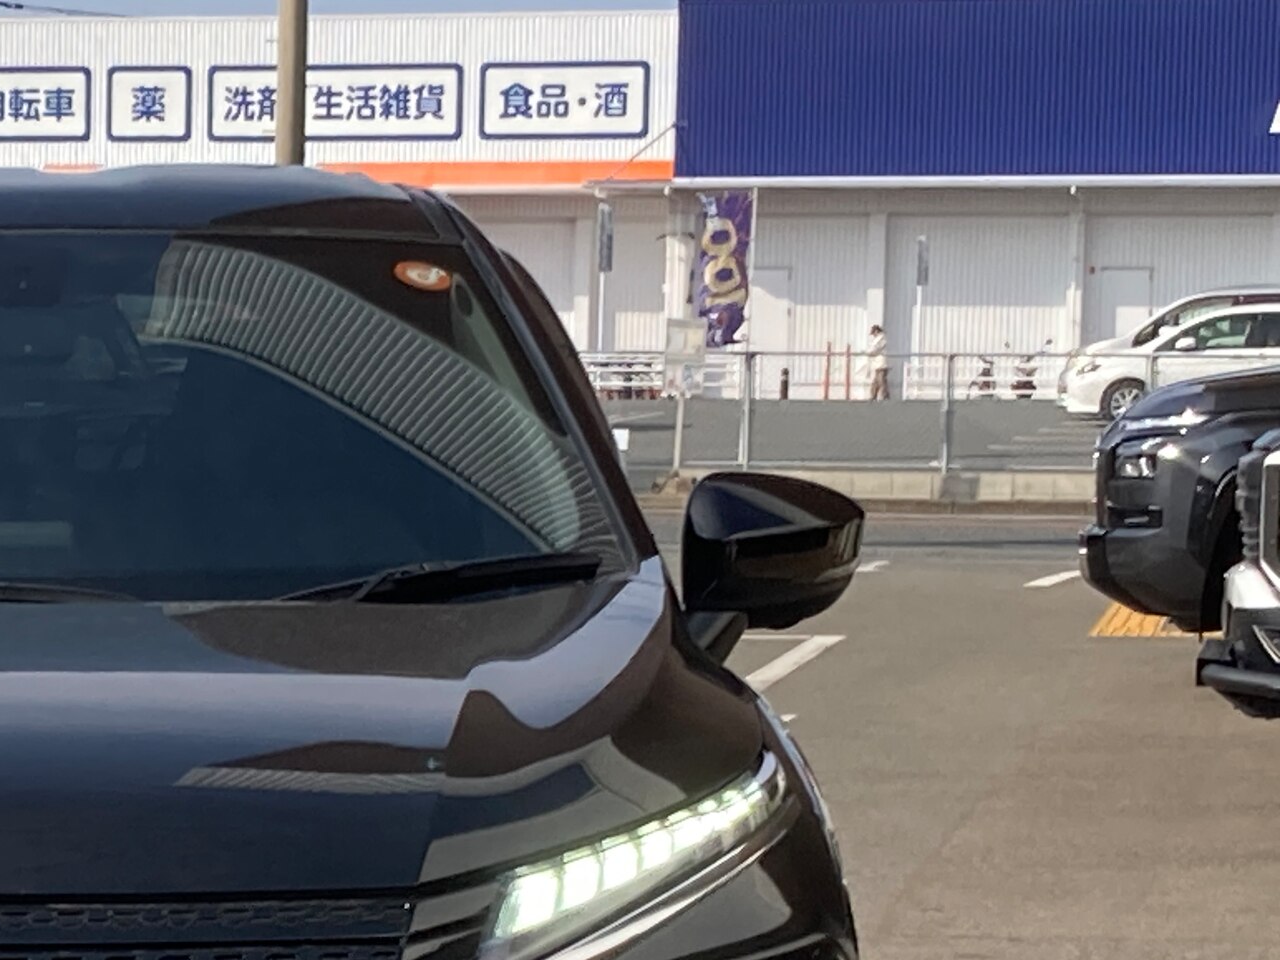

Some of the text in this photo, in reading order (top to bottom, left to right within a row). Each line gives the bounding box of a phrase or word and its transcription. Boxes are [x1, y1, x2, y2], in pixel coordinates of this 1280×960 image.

[131, 86, 166, 122] 薬
[223, 84, 445, 122] 洗剤生活雑貨
[499, 82, 629, 119] 食品・酒
